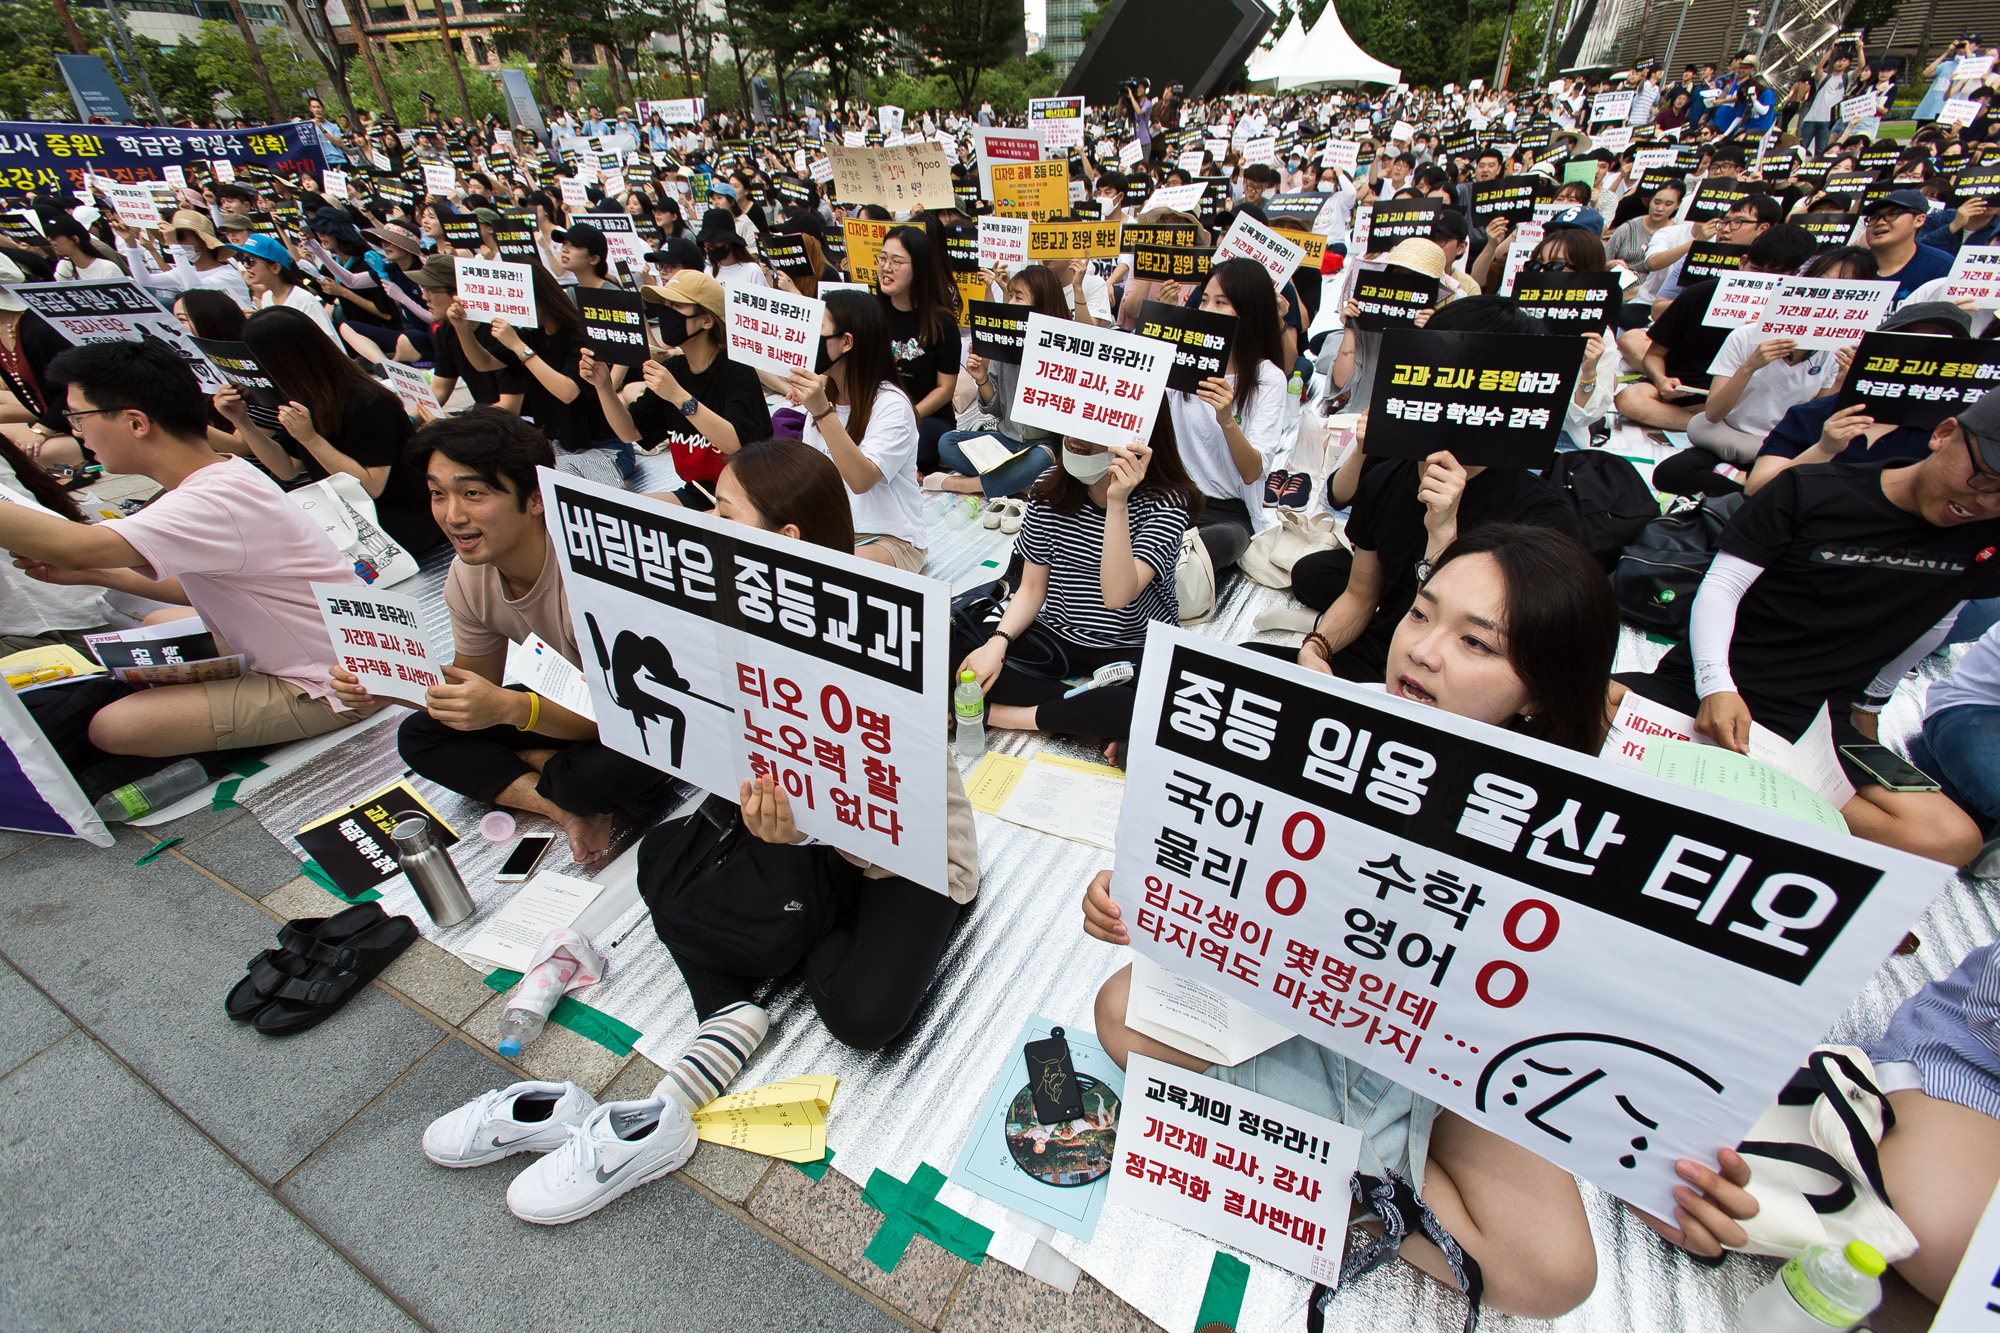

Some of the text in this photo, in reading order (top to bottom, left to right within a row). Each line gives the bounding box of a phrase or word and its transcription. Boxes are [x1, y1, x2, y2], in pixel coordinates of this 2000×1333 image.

[44, 133, 104, 158] 증원!
[116, 135, 183, 157] 학급당
[187, 135, 244, 156] 학생수
[247, 132, 289, 155] 감축!
[888, 165, 906, 180] 174
[918, 161, 940, 176] 7000
[995, 164, 1064, 180] 디자인 공예 중등 티오
[1504, 186, 1533, 198] 증원하라
[1494, 201, 1515, 211] 학생수
[1404, 211, 1435, 221] 증원하라
[847, 222, 869, 237] 디자인
[1000, 224, 1023, 234] 정유라!!
[1239, 222, 1266, 245] 교육계의
[1393, 226, 1415, 236] 학생수
[1822, 224, 1850, 232] 증원하라
[1031, 226, 1116, 251] 전문교과 정원 확보
[998, 251, 1023, 262] 결사반대!
[1304, 240, 1322, 258] 확보
[1691, 253, 1724, 263] 교과 교사
[1136, 251, 1171, 273] 전문교과
[1173, 252, 1194, 274] 정원
[492, 269, 523, 282] 정유라!!
[855, 267, 870, 281] 법적
[1959, 270, 1993, 281] 기간제
[507, 288, 524, 298] 강사
[1727, 278, 1764, 290] 교육계의
[1781, 285, 1881, 302] 교육계의 정유라!!
[1947, 286, 1990, 298] 정규직화
[22, 287, 154, 312] 학급당 학생수 감소
[1360, 285, 1429, 304] 교과 교사 증원하라
[1519, 289, 1608, 301] 교과 교사 증원하라
[1722, 293, 1749, 305] 기간제
[494, 303, 530, 315] 결사반대!
[733, 290, 811, 322] 교육계의 정유라!!
[1357, 301, 1405, 318] 학급당 학생수
[1548, 307, 1603, 320] 학생수 감축
[1711, 307, 1747, 319] 정규직화
[1775, 304, 1869, 321] 기간제 교사, 강사
[98, 318, 133, 333] 티오
[583, 307, 640, 325] 교과 교사 증원하라
[974, 315, 1002, 329] 교과 교사
[586, 326, 644, 345] 학급당 학생수 감축
[735, 313, 806, 344] 기간제 교사, 강사
[975, 330, 1015, 346] 학급당 학생수
[1142, 322, 1226, 351] 교과 교사 증원하라
[1761, 322, 1866, 340] 정규직화 결사반대!
[732, 334, 808, 368] 정규직화 결사반대!
[1038, 329, 1155, 373] 교육계의 정유라!!
[1197, 355, 1221, 373] 감축
[1864, 356, 1938, 376] 교과 교사
[1035, 360, 1144, 402] 기간제 교사, 강사
[1391, 364, 1561, 394] 교과 교사 증원하라
[1855, 379, 1960, 401] 학급당 학생수
[1022, 387, 1143, 434] 정규직화 결사반대!
[1386, 397, 1550, 429] 학급당 학생수 감축
[1841, 546, 1965, 571] DESCENTE
[560, 501, 921, 672] 버림받은 중등교과
[327, 598, 418, 629] 교육계의 정유라!!
[340, 628, 426, 659] 기간제 교사, 강사
[344, 656, 440, 687] 정규직화 결사반대!
[735, 661, 892, 755] 티오 0명
[744, 709, 901, 805] 노오력 할
[364, 805, 389, 822] 교과
[829, 787, 904, 847] 없다
[1168, 669, 1283, 761] 중등
[1302, 717, 1437, 816] 임용
[1455, 772, 1626, 877] 울산
[1640, 834, 1839, 957] 티오
[338, 818, 399, 875] 학급당 학생수 감축
[1165, 769, 1264, 847] 국어
[1281, 811, 1326, 861] 0
[1358, 852, 1486, 933] 수학
[1502, 898, 1560, 953] 0
[789, 900, 804, 909] NIKE
[1144, 876, 1273, 957] 임고생이
[1154, 826, 1529, 1009] 물리 0 영어 0
[1136, 907, 1261, 988] 타지역도
[1145, 1076, 1331, 1166] 교육계의 정유라!!
[1143, 1116, 1322, 1203] 기간제 교사, 강사
[1125, 1151, 1327, 1252] 정규직화 결사반대!
